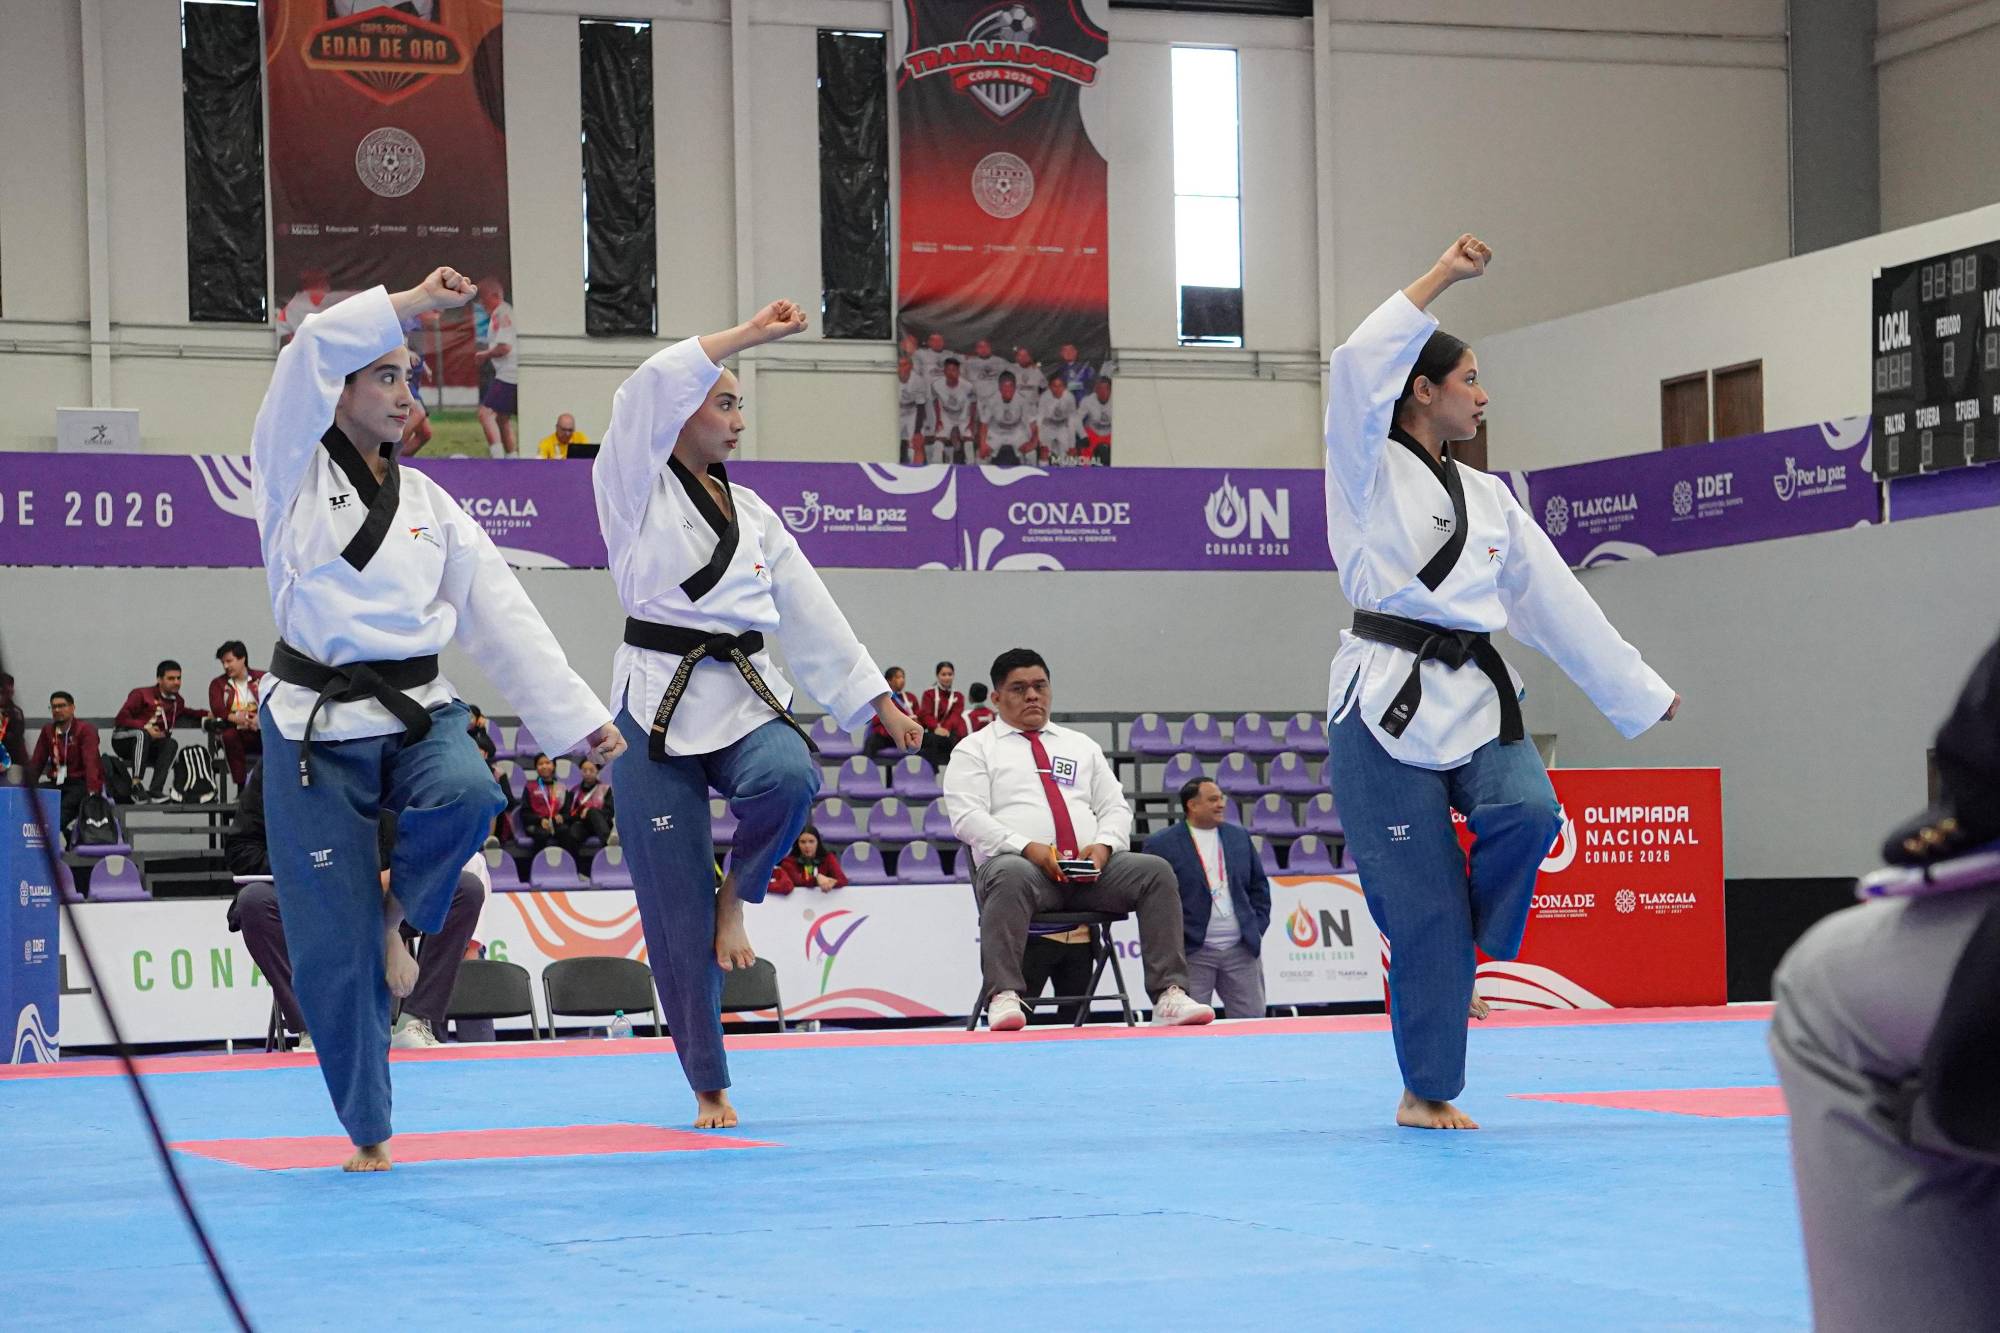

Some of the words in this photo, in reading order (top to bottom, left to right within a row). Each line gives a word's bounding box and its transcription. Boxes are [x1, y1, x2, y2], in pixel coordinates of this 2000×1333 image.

[321, 36, 370, 57] EDAD
[379, 38, 402, 58] DE
[410, 39, 446, 60] ORO
[905, 41, 1096, 85] TRABAJADORES
[968, 71, 999, 82] COPA
[1003, 71, 1034, 84] 2026
[1879, 310, 1911, 351] LOCAL
[1936, 314, 1961, 338] PERIODO
[1915, 405, 1940, 429] T.FUERA
[1955, 398, 1980, 422] T.FUERA
[1884, 412, 1906, 435] FALTAS
[1051, 455, 1103, 467] MUNDIAL
[1697, 472, 1734, 499] IDET
[1797, 468, 1816, 487] Por
[1817, 465, 1827, 483] la
[1828, 465, 1846, 486] paz
[65, 490, 174, 528] 2026
[460, 498, 538, 517] XCALA
[823, 504, 855, 521] Por
[857, 503, 874, 521] la
[876, 508, 907, 525] paz
[1008, 502, 1130, 525] CONADE
[1571, 493, 1638, 518] TLAXCALA
[485, 519, 532, 528] HISTORIA
[1205, 543, 1253, 556] CONADE
[1259, 543, 1290, 556] 2026
[1055, 761, 1073, 776] 38
[1584, 806, 1689, 823] OLIMPIADA
[1586, 829, 1699, 845] NACIONAL
[1585, 851, 1633, 864] CONADE
[1640, 850, 1670, 863] 2026
[1530, 894, 1595, 909] CONADE
[1639, 892, 1697, 904] TLAXCALA
[133, 948, 272, 991] CONA
